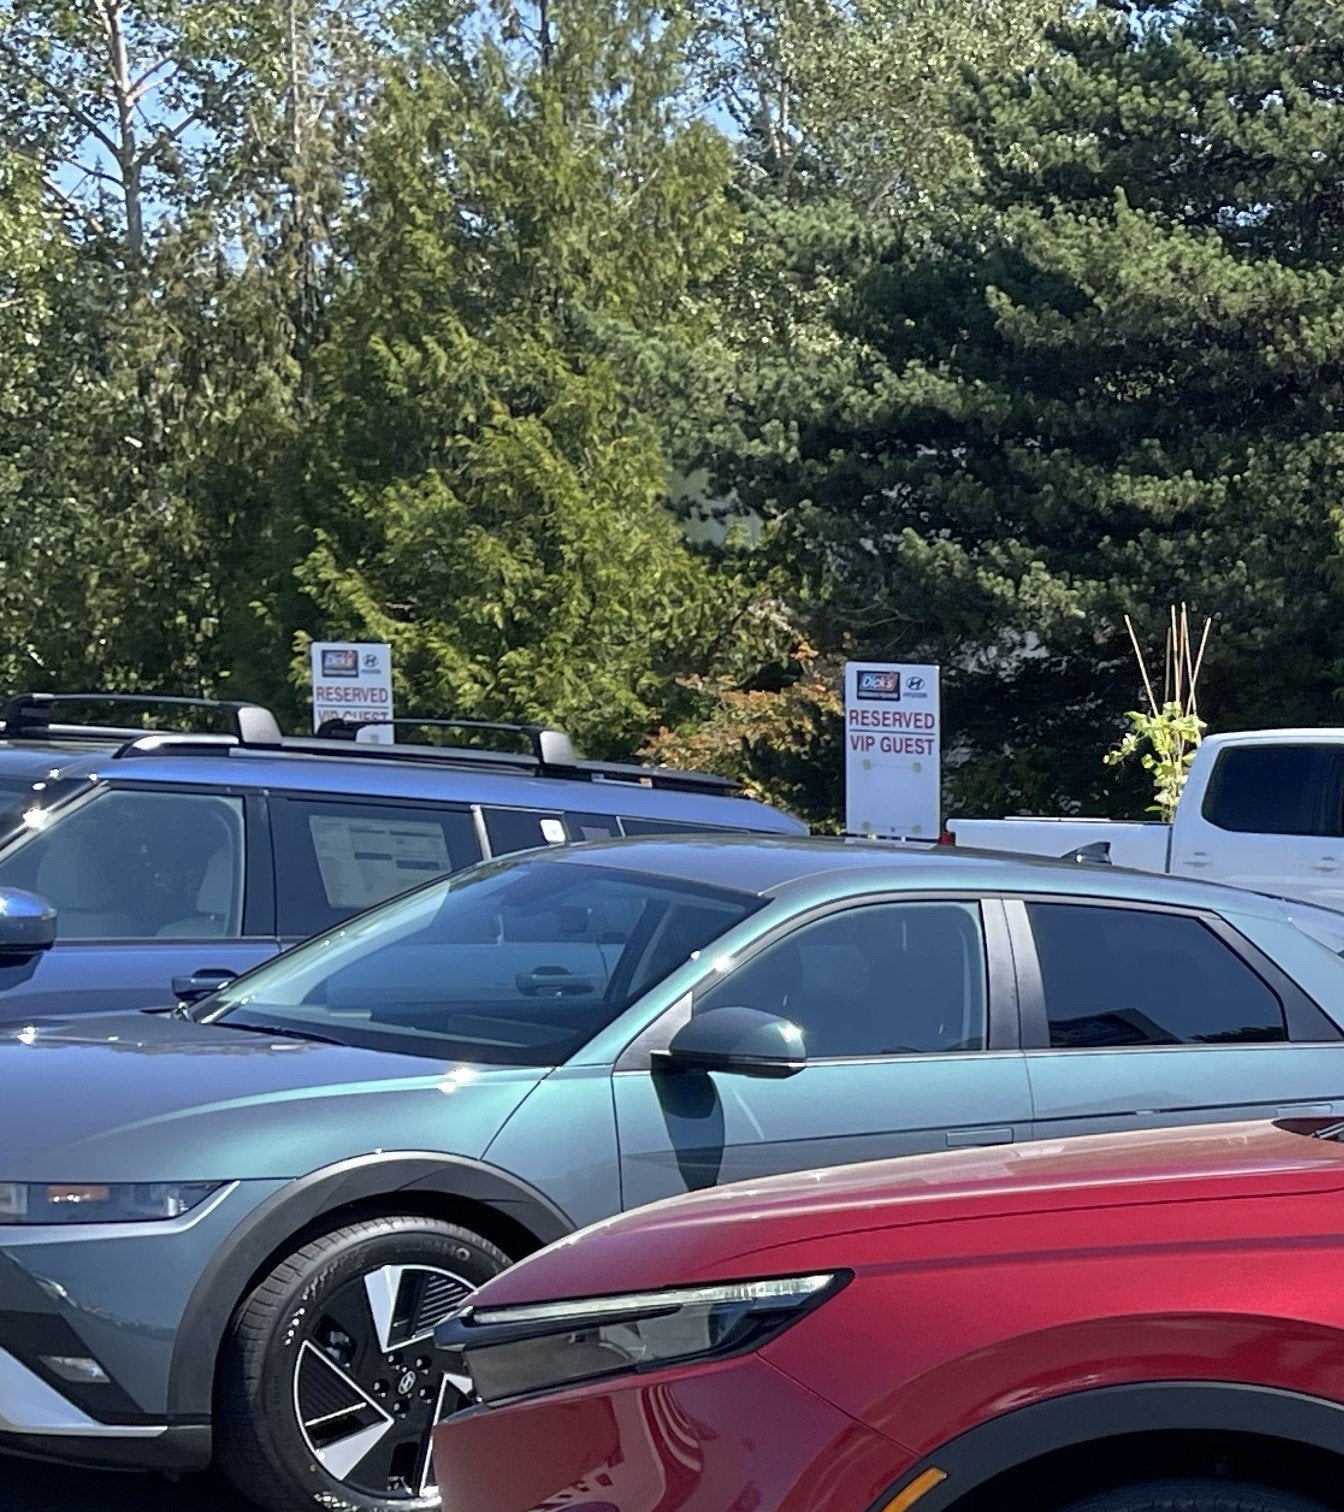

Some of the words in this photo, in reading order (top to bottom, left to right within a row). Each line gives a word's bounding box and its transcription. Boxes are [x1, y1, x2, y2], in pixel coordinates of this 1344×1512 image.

[315, 686, 389, 703] RESERVED
[849, 709, 935, 730] RESERVED
[849, 735, 875, 752] VIP
[880, 736, 935, 756] GUEST
